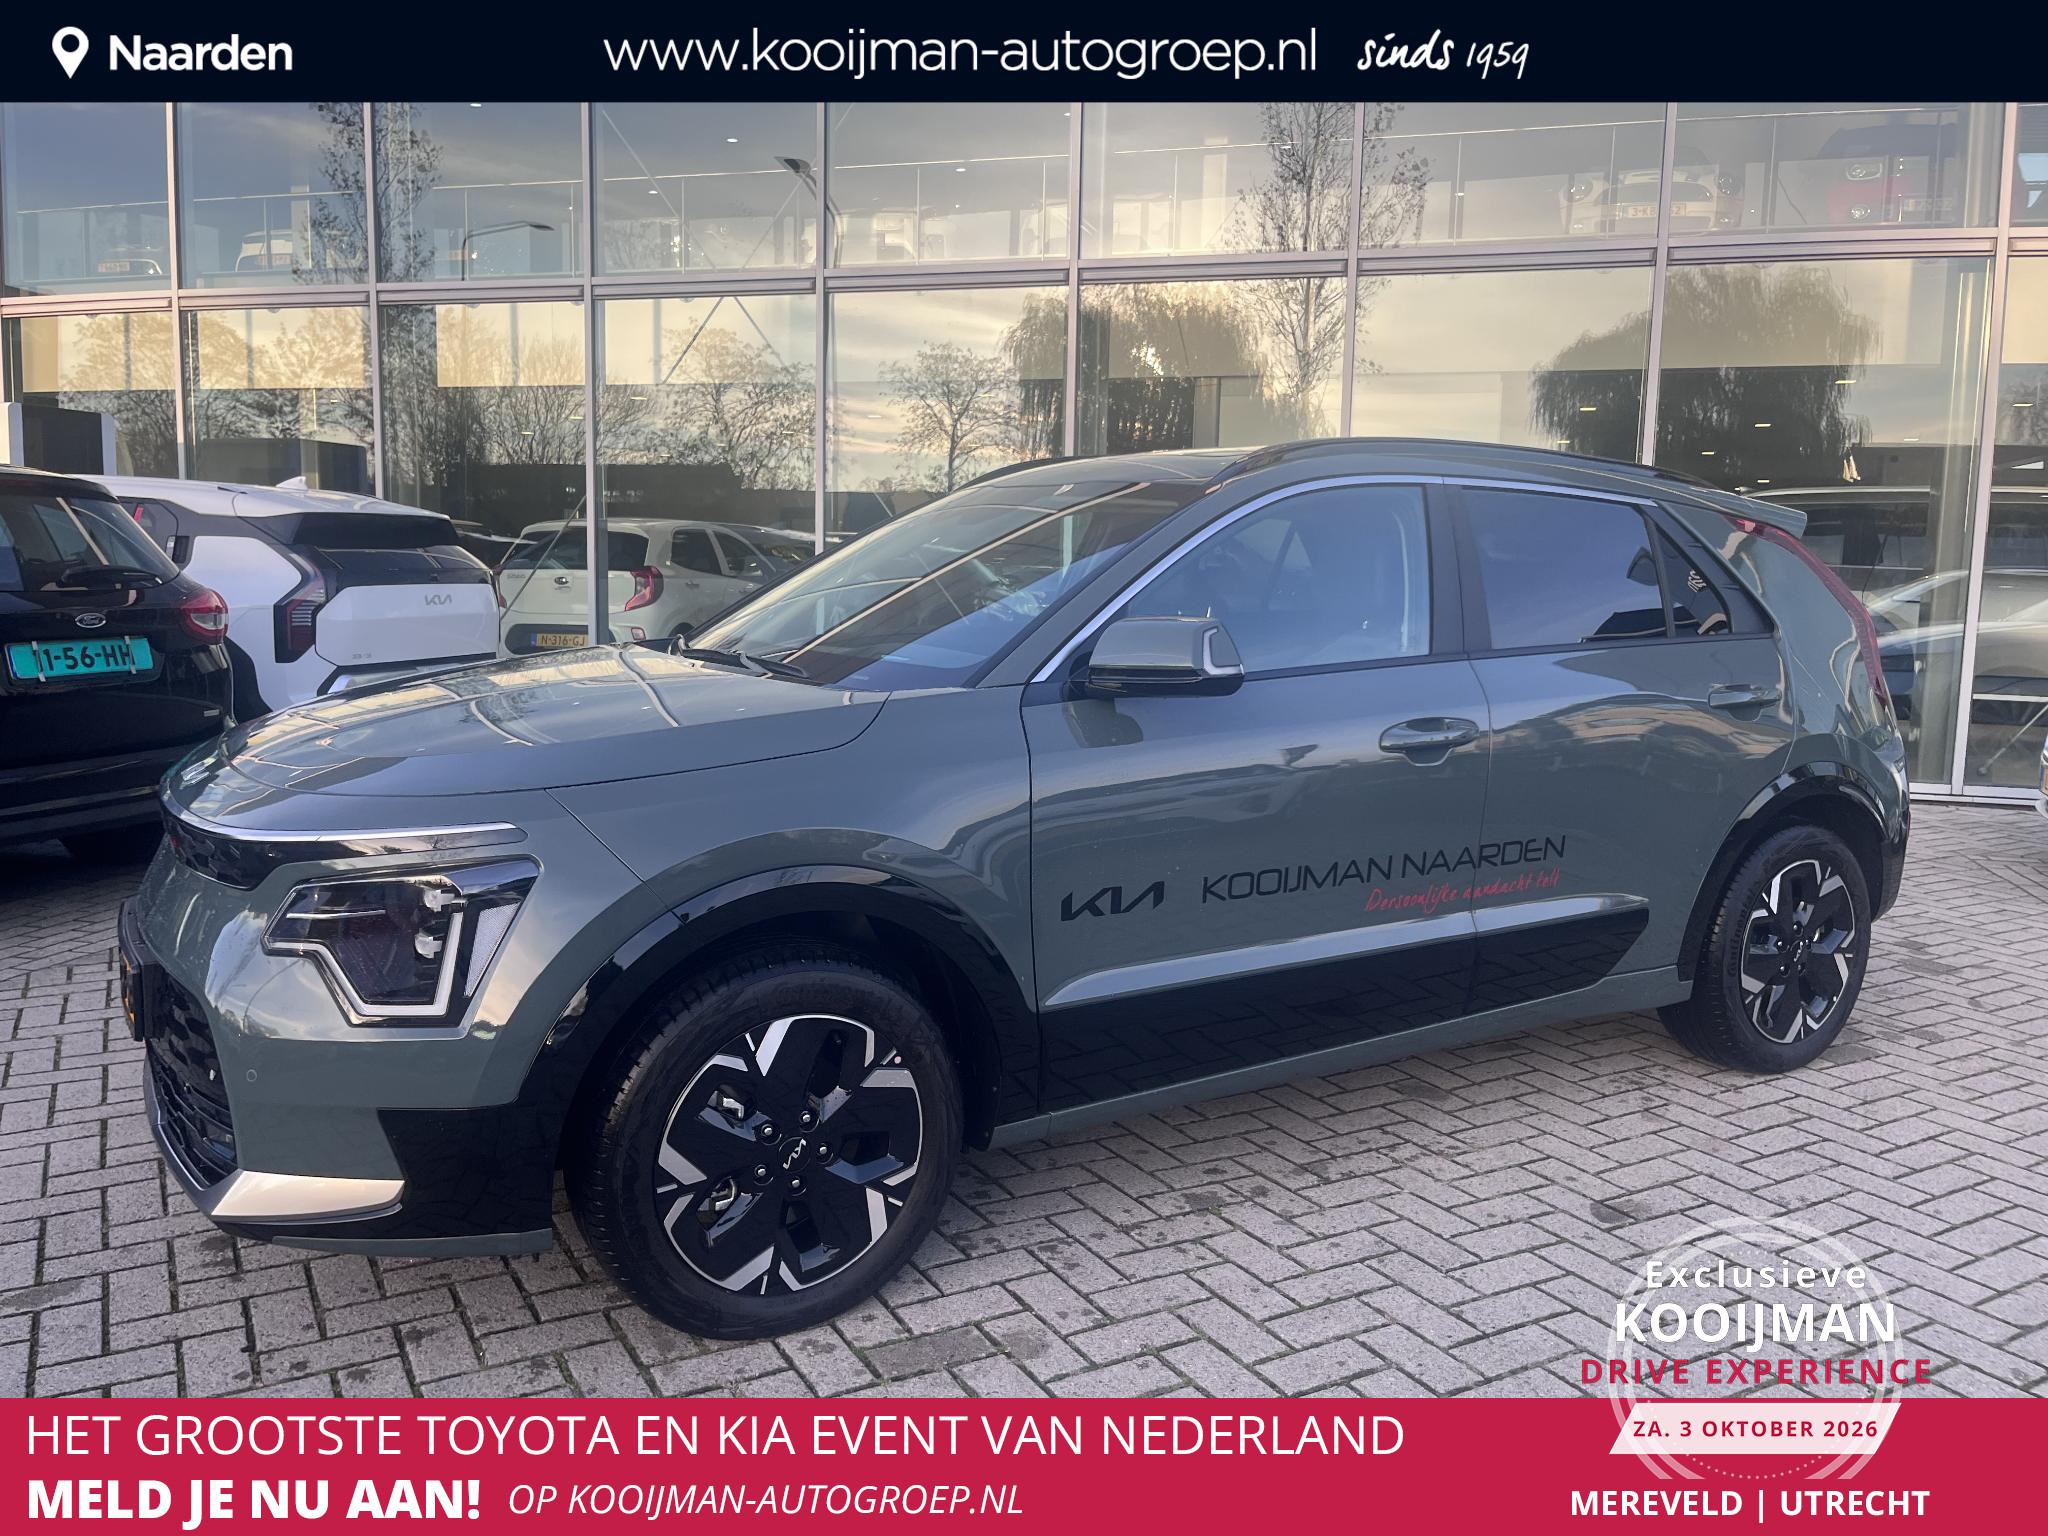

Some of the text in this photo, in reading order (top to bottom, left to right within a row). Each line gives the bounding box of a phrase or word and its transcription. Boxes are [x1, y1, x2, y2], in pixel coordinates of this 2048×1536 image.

[541, 635, 585, 646] N-316-GJ
[1202, 834, 1566, 904] KOOIJMAN NAARDEN
[1060, 880, 1166, 922] KIA
